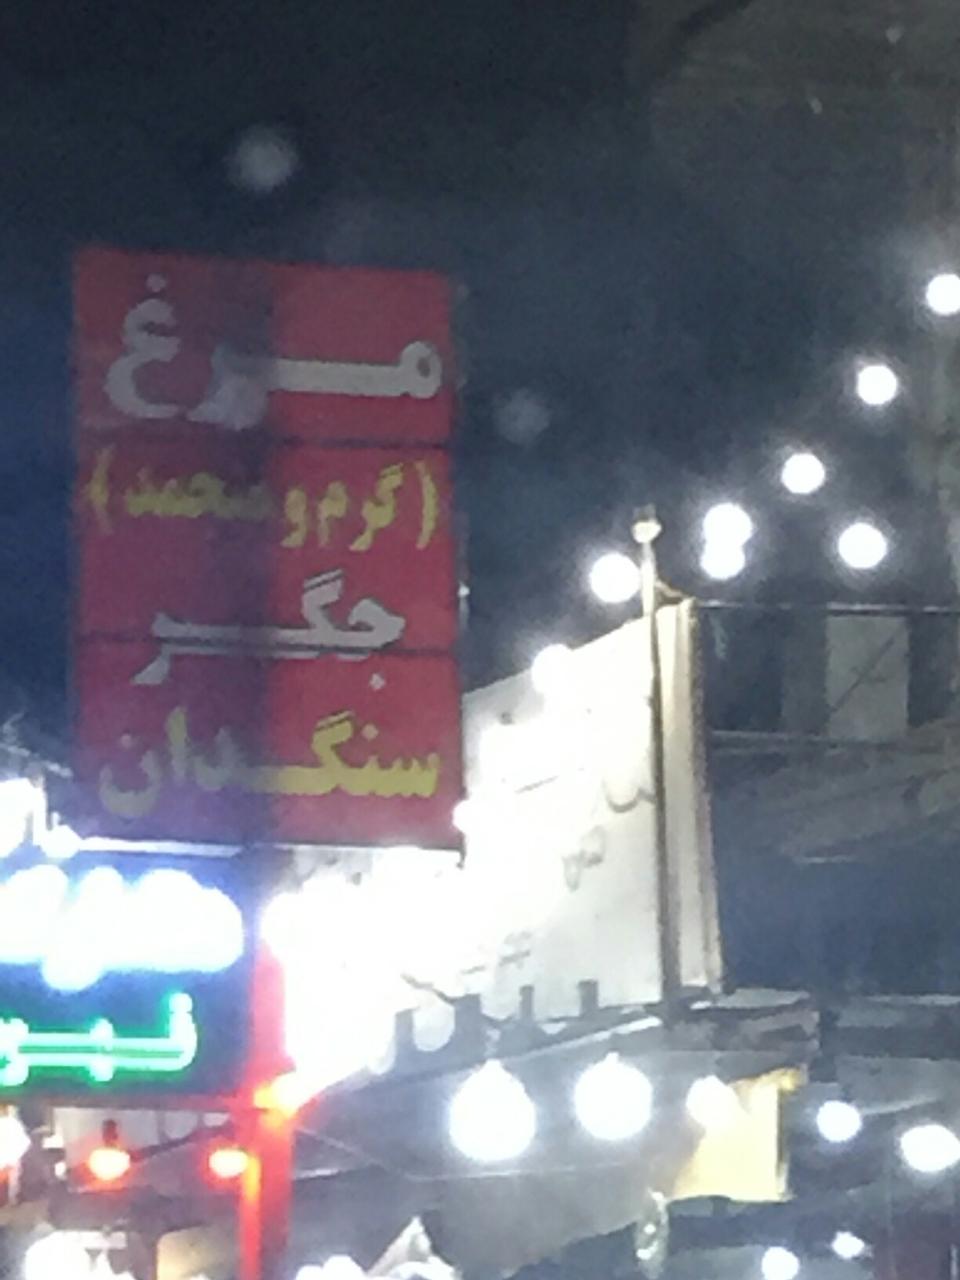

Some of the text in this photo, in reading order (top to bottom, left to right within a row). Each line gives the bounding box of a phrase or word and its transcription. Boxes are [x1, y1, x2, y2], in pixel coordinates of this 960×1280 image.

[105, 272, 443, 430] مرغ
[280, 486, 308, 548] و
[132, 568, 406, 690] جگر
[100, 708, 441, 820] سنگدان
